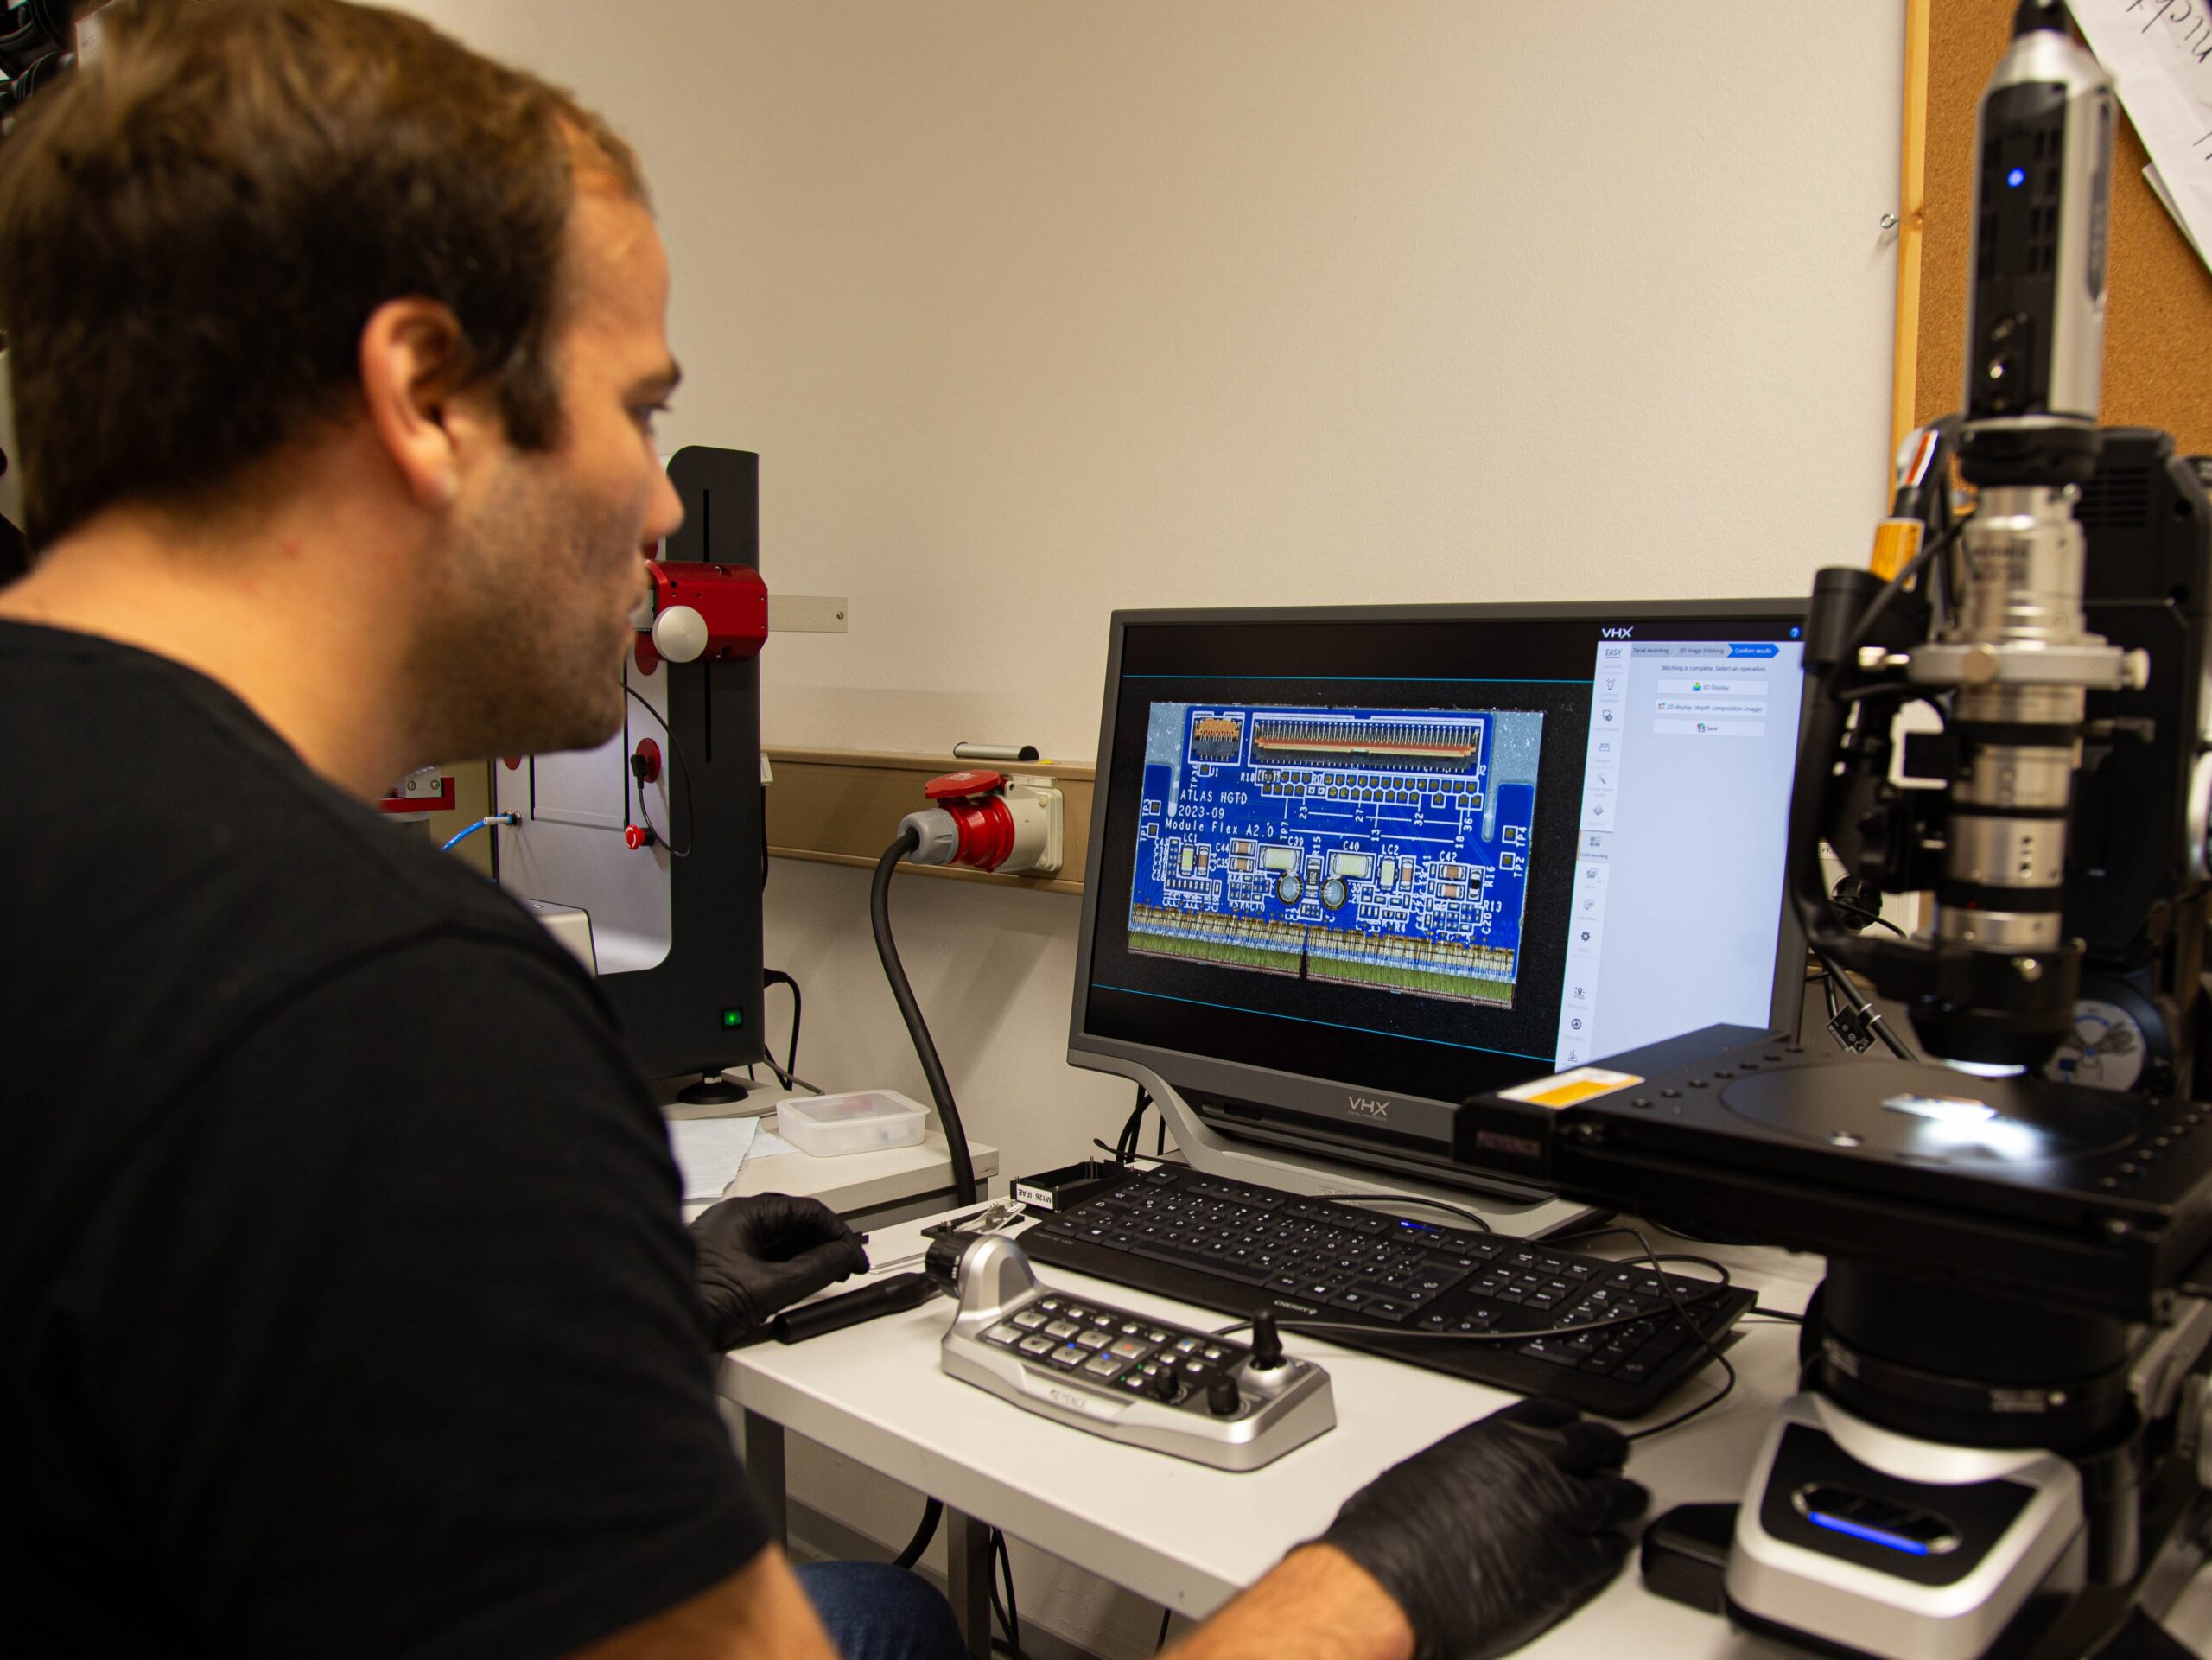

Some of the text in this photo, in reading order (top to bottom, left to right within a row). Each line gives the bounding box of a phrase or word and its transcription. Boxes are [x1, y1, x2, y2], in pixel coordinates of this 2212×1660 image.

[1601, 626, 1634, 639] VHX
[1605, 648, 1622, 657] EASY
[1179, 789, 1248, 805] ATLAS HGTD
[1142, 798, 1151, 817] TP3
[1178, 805, 1225, 819] 2023-09
[1299, 805, 1308, 820] 23
[1355, 808, 1364, 823] 27
[1414, 812, 1424, 827] 32
[1165, 818, 1274, 838] Module Flex A2.0
[1280, 821, 1289, 840] TP7
[1463, 817, 1474, 832] 36
[1184, 833, 1198, 843] LC1
[1287, 836, 1304, 847] C39
[1370, 829, 1381, 842] 13
[1455, 836, 1465, 849] 18
[1516, 826, 1528, 847] TP4
[1216, 842, 1230, 853] C44
[1312, 836, 1322, 856] R15
[1343, 841, 1360, 851] C40
[1382, 844, 1399, 855] LC2
[1439, 850, 1458, 862] C42
[1513, 856, 1525, 878] TP2
[1484, 866, 1496, 887] R16
[1484, 899, 1503, 913] R13
[1481, 913, 1493, 935] C20
[1348, 1096, 1391, 1116] VHX
[1018, 1188, 1052, 1204] M126 IFAE
[1274, 1300, 1307, 1313] CHERRY
[1050, 1388, 1087, 1410] KEYENCE
